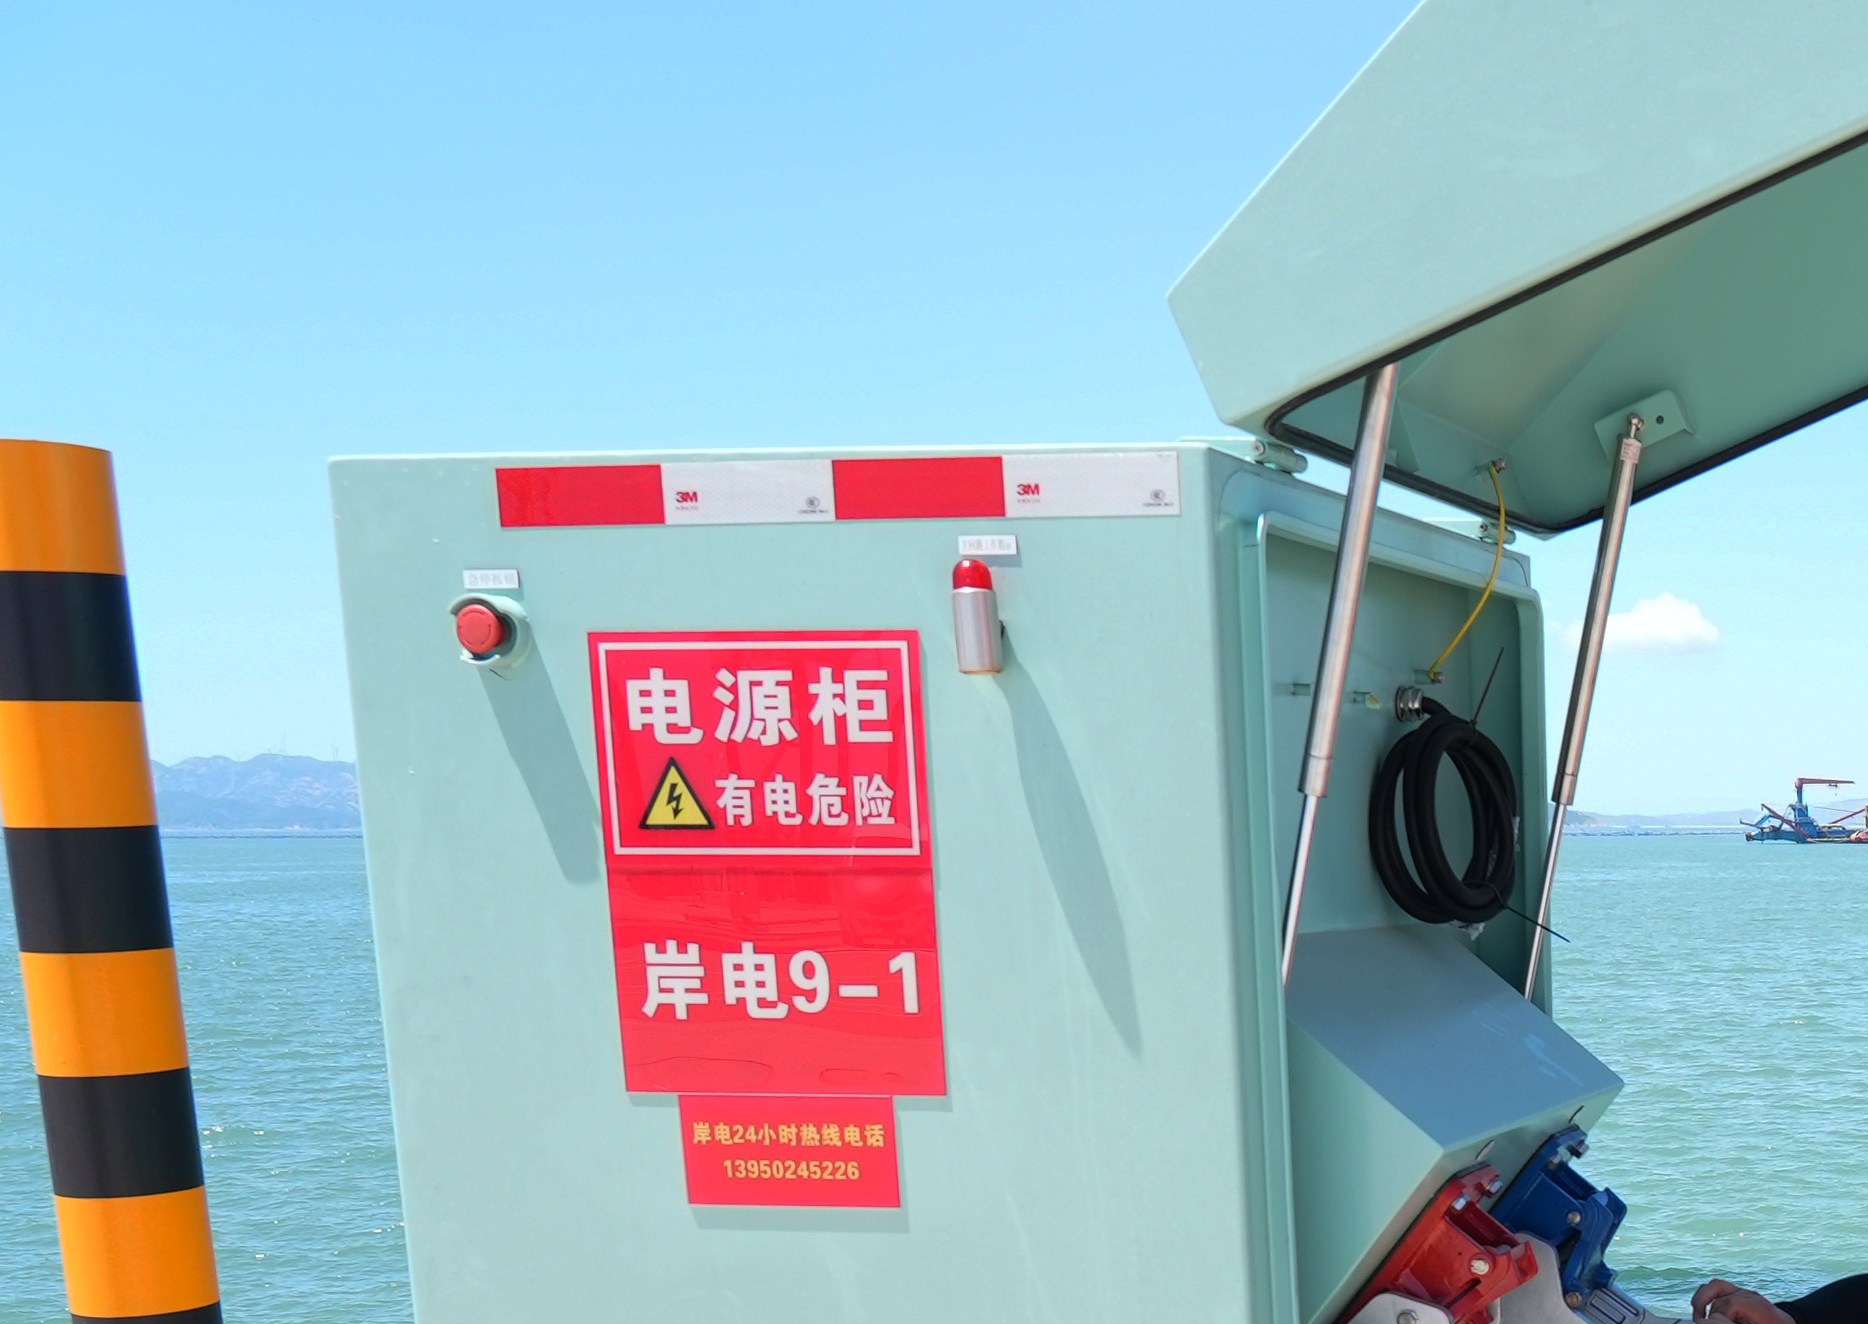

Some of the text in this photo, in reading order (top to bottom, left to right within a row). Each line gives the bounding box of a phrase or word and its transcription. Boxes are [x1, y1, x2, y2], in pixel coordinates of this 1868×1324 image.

[675, 491, 699, 504] 3M
[1016, 483, 1041, 496] 3M
[625, 666, 894, 747] 电源柜
[715, 772, 896, 827] 有电危险
[641, 939, 920, 1020] 岸电9-1
[692, 1121, 886, 1148] 岸电24小时热线电话
[723, 1159, 861, 1180] 13950245226
